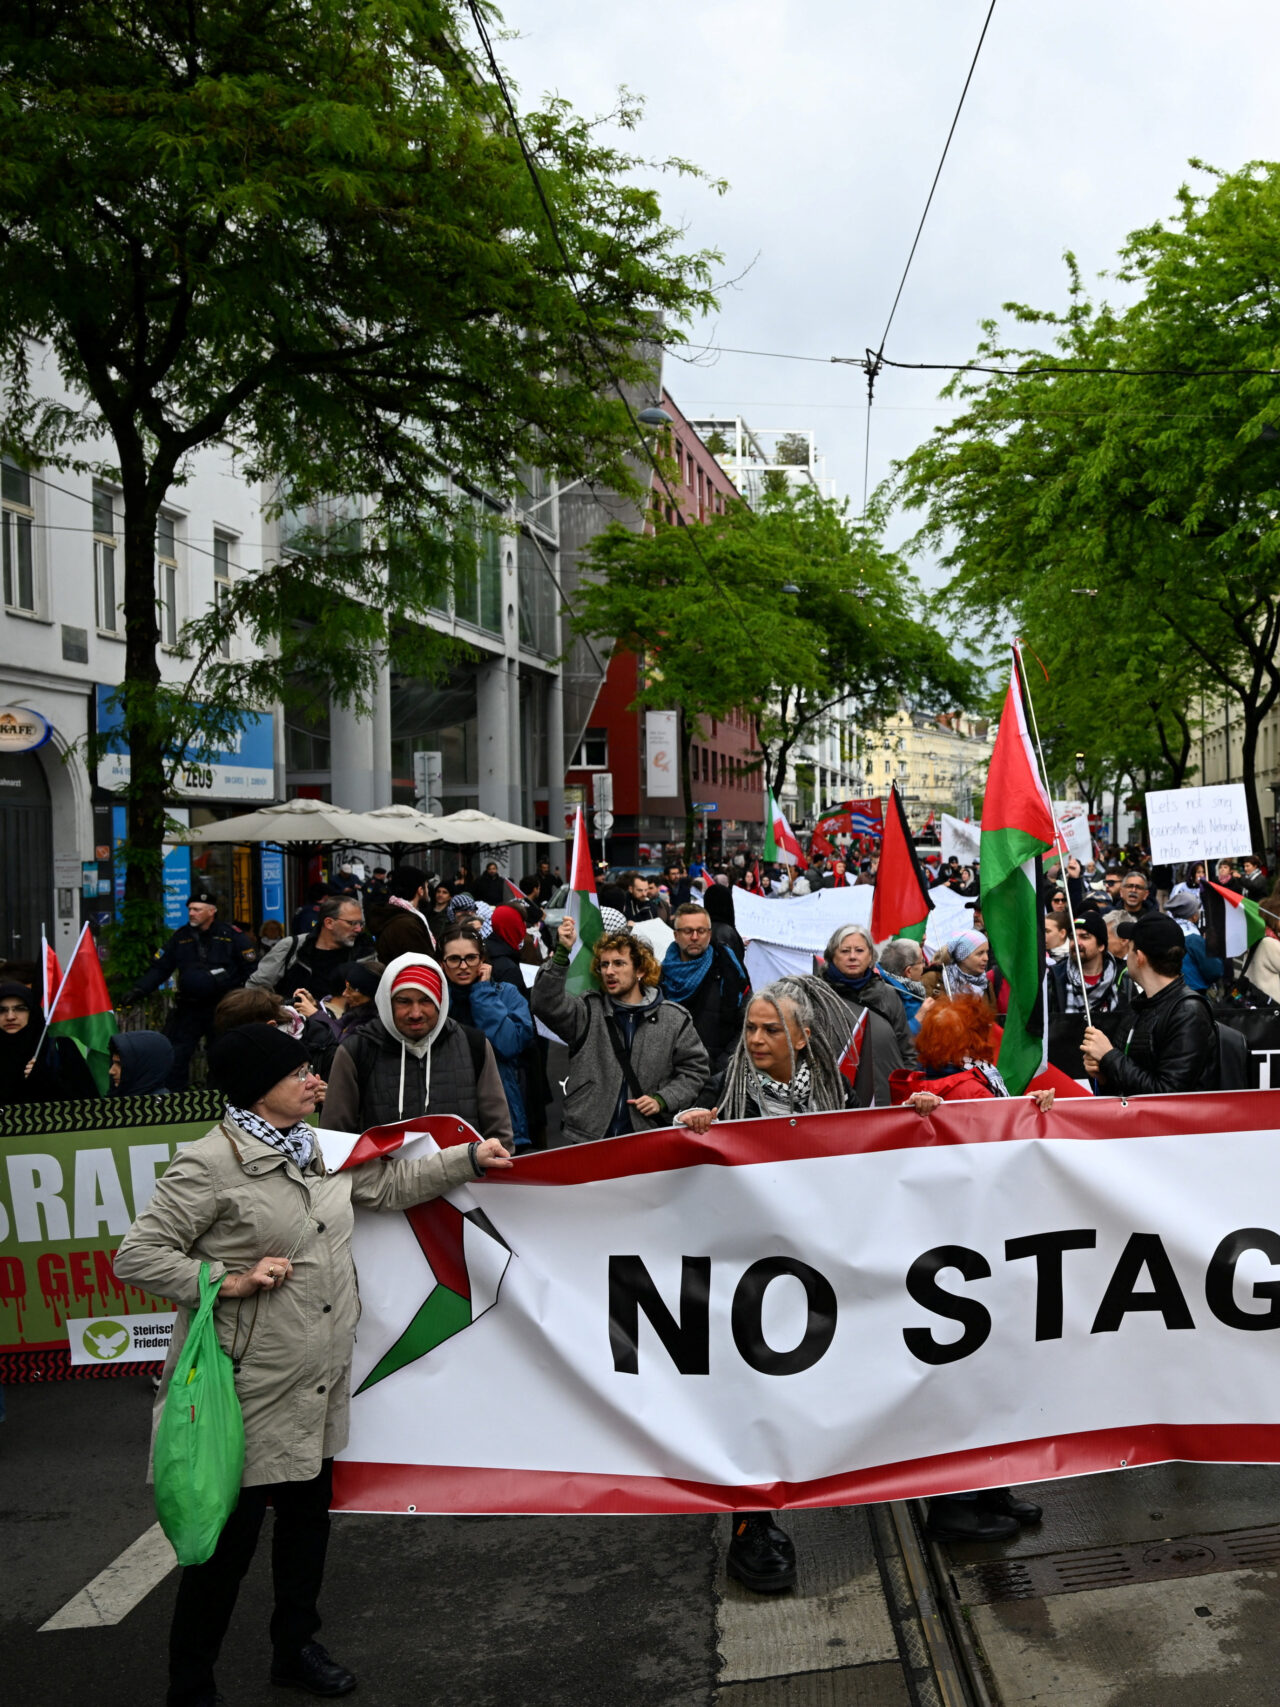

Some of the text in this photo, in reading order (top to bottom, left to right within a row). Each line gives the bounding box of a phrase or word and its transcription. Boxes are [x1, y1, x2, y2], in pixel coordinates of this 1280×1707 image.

[185, 767, 213, 789] ZEUS
[608, 1255, 838, 1377] NO
[134, 1337, 172, 1349] Frieden
